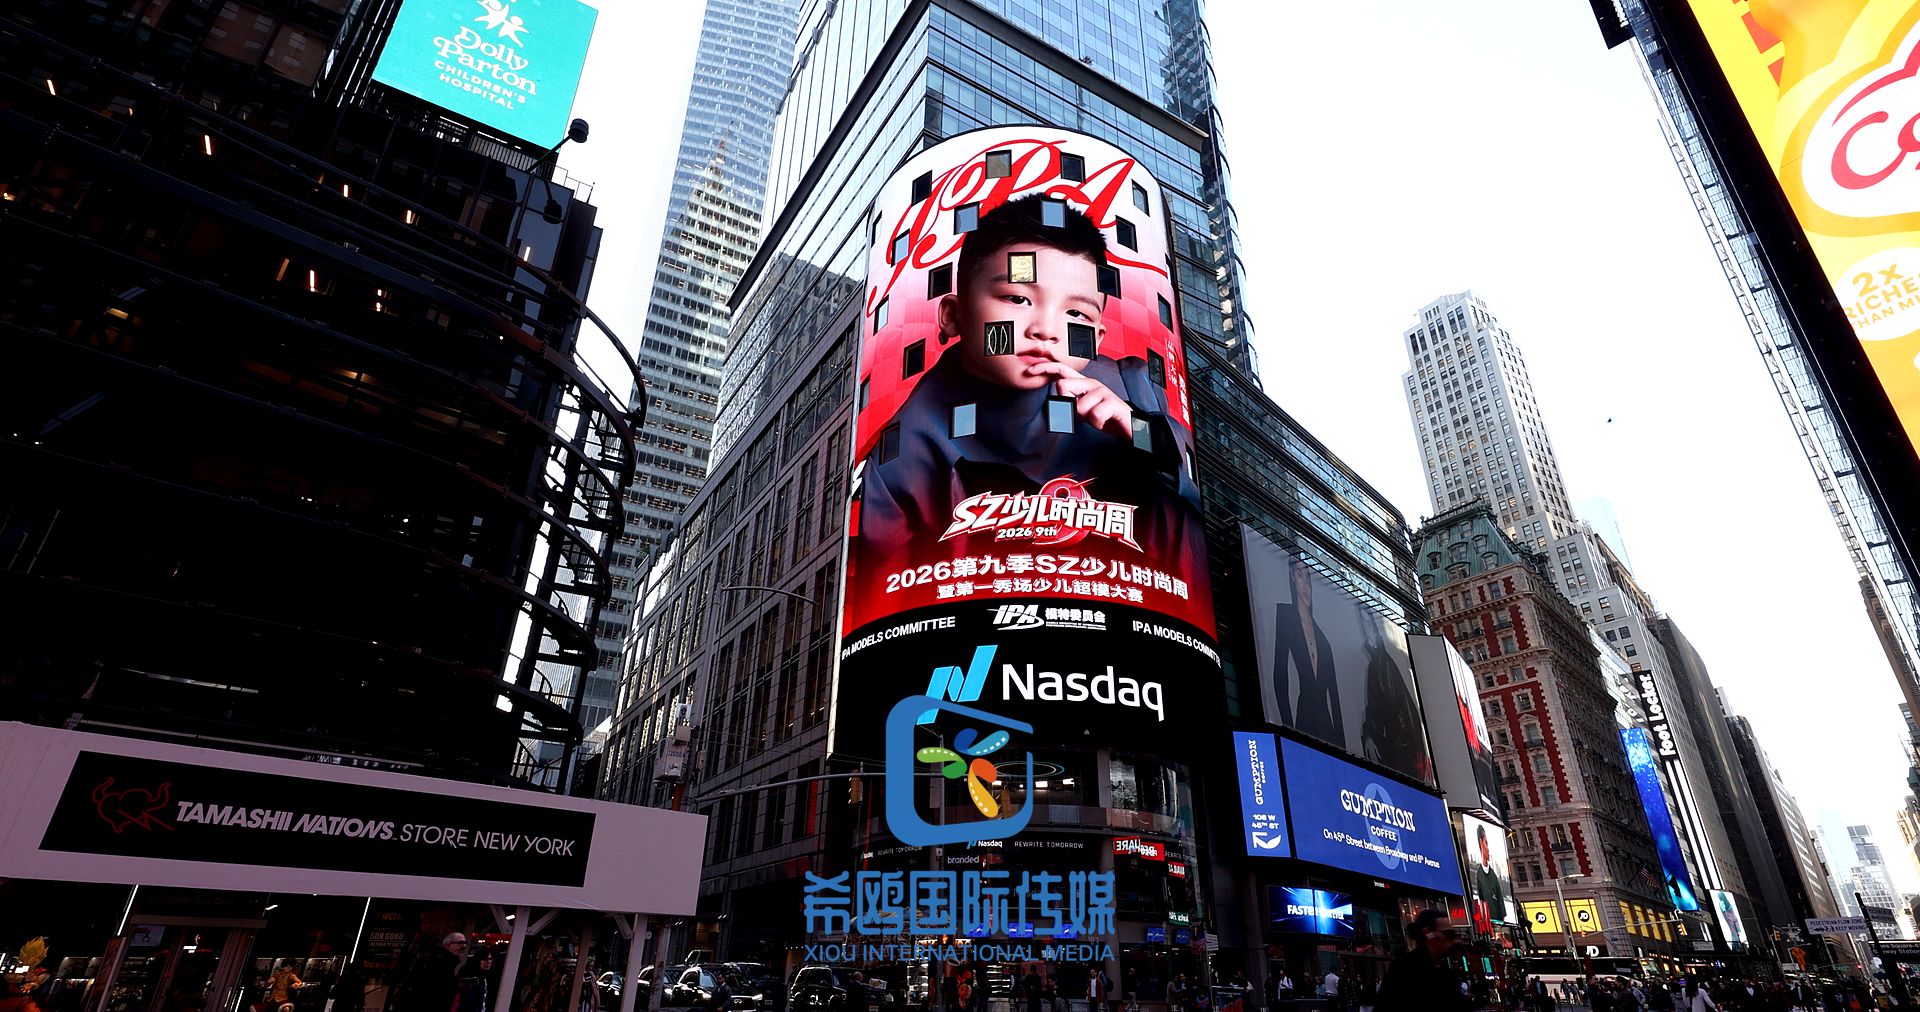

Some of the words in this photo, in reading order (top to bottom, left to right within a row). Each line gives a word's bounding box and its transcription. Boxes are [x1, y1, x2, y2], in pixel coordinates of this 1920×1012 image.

[433, 36, 536, 95] Parton
[454, 26, 528, 70] Dolly
[434, 60, 526, 104] CHILDREN'S
[439, 73, 514, 110] HOSPITAL
[1845, 275, 1920, 319] RICHE
[1852, 306, 1894, 328] HAN
[997, 527, 1032, 539] 2026
[1035, 526, 1058, 537] 9th
[886, 554, 1189, 600] 2026第九季SZ少儿时尚周
[937, 577, 1144, 603] 暨第一秀场少儿超模大赛
[851, 631, 884, 655] MODELS
[884, 616, 956, 640] COMMITTEE
[990, 604, 1044, 630] IPA
[1132, 620, 1152, 634] IPA
[1153, 624, 1192, 647] MODELS
[1002, 664, 1165, 722] Nasdaq
[1639, 674, 1665, 721] Locker
[1653, 723, 1677, 756] Foot
[1248, 740, 1264, 805] GUMPTION
[176, 801, 293, 832] TAMASHII
[292, 814, 395, 840] NATIONS
[400, 824, 469, 848] STORE
[474, 831, 520, 851] NEW
[524, 835, 575, 857] YORK
[1340, 789, 1416, 832] GUMPTION
[978, 840, 1003, 848] Nasdaq
[1323, 828, 1334, 840] On
[1346, 834, 1364, 849] Street
[1364, 839, 1386, 855] between
[1386, 846, 1408, 863] Broadway
[1409, 853, 1418, 863] and
[1370, 825, 1398, 841] COFFEE
[947, 855, 980, 864] branded
[1586, 945, 1600, 957] JD
